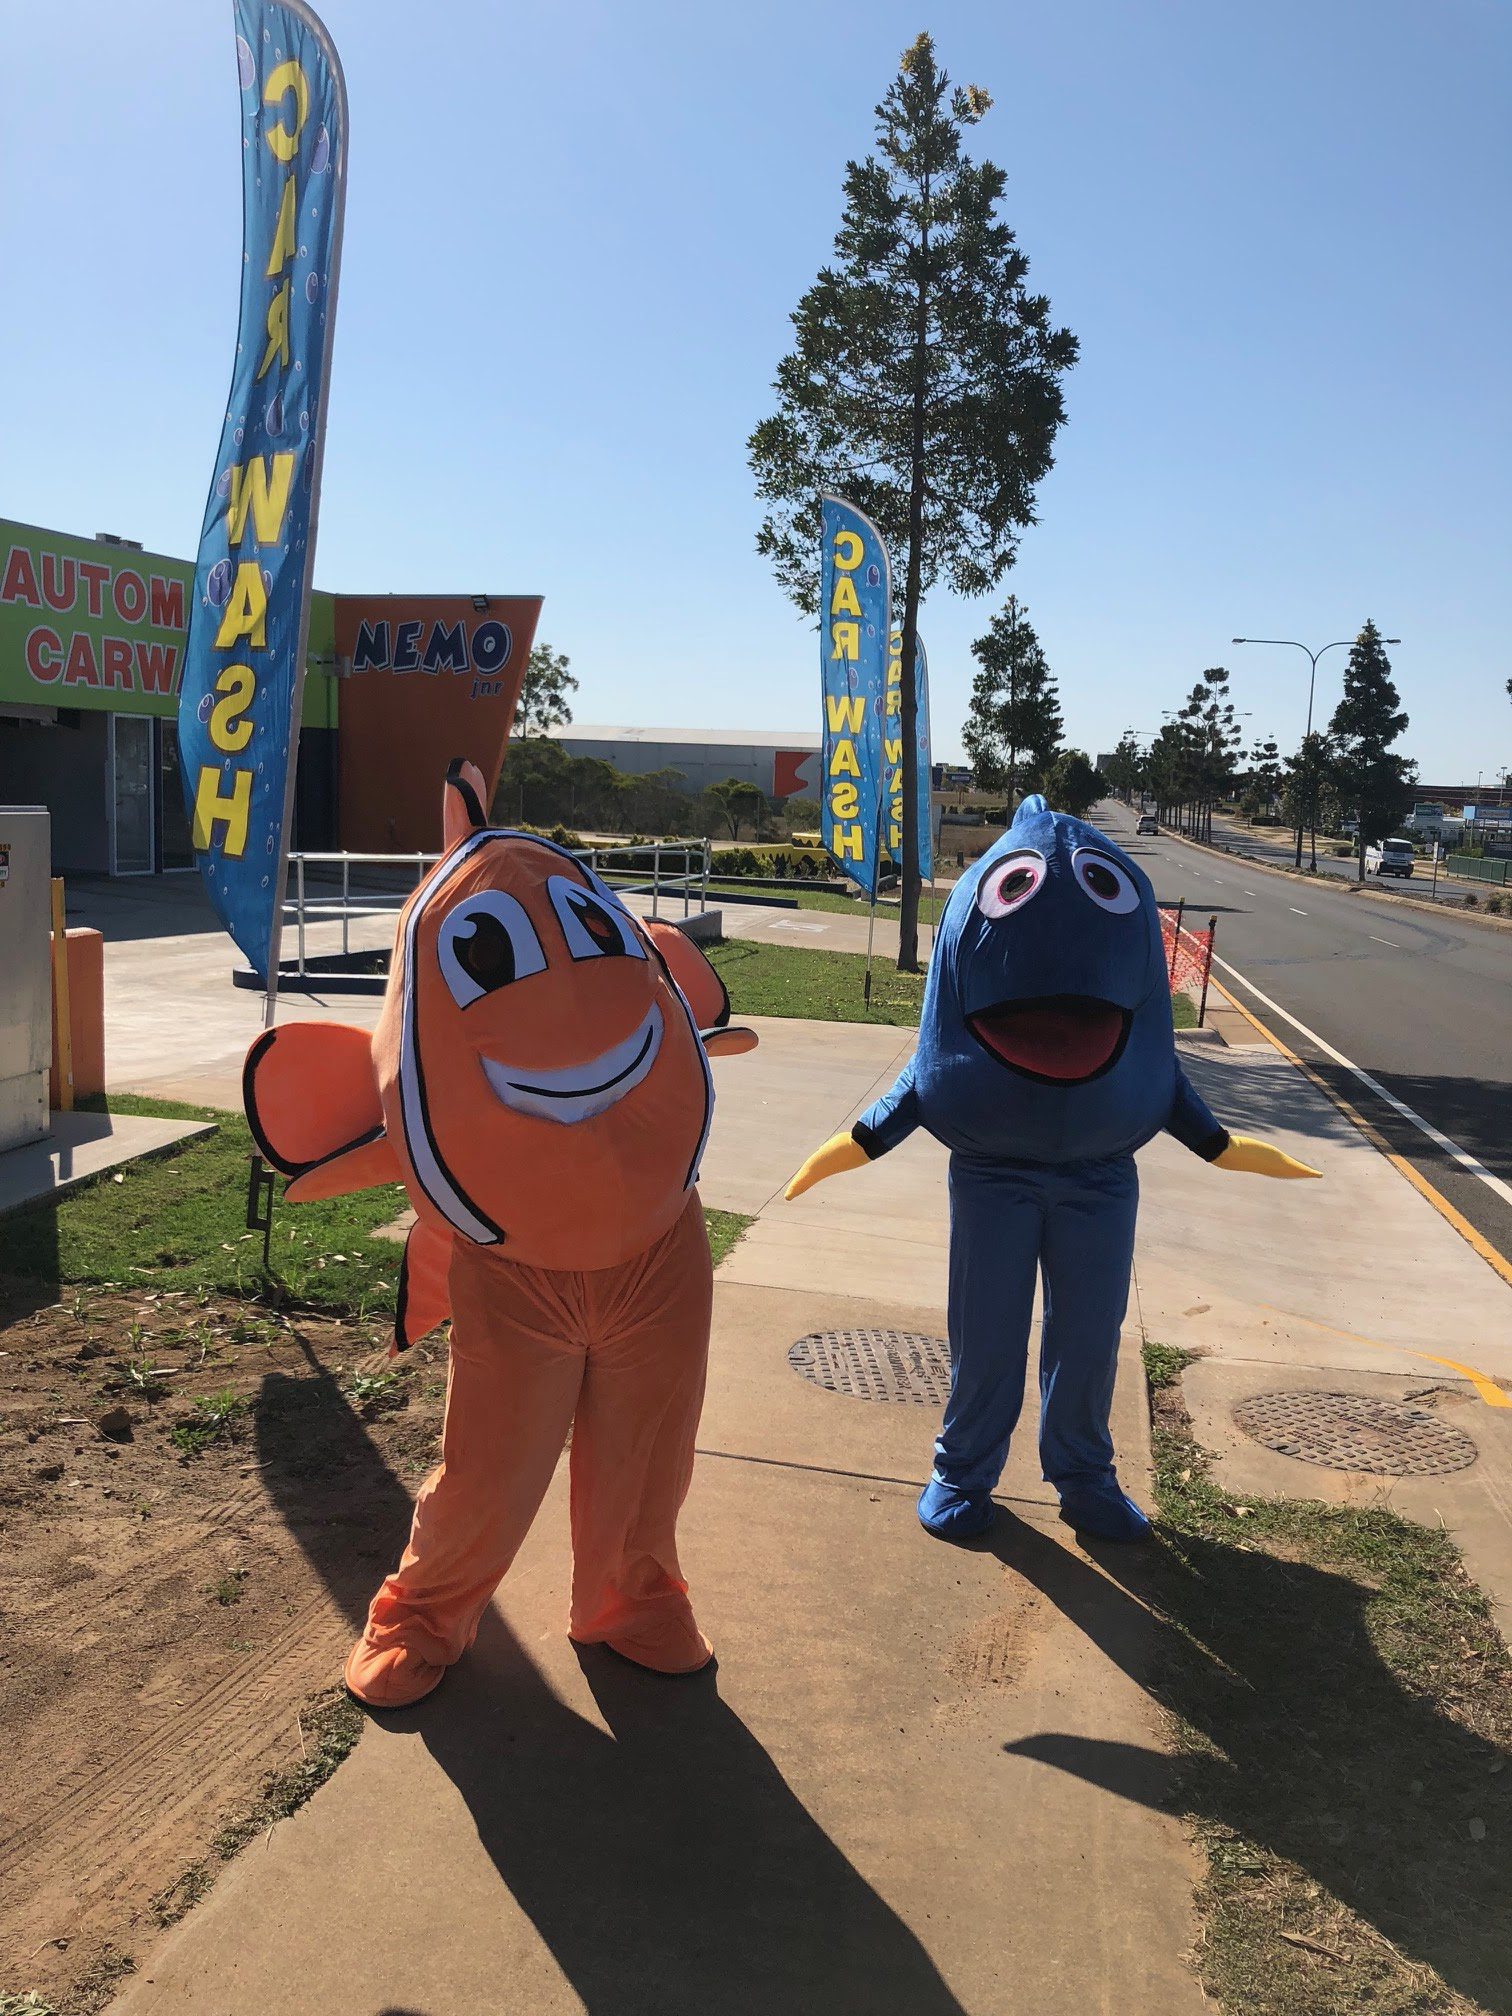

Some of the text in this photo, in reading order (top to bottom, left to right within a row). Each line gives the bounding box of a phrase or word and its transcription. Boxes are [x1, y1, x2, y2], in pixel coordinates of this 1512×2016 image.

[1, 546, 188, 632] AUTOM
[25, 625, 184, 696] CARW
[352, 618, 513, 676] NEMO
[470, 678, 503, 700] jnr
